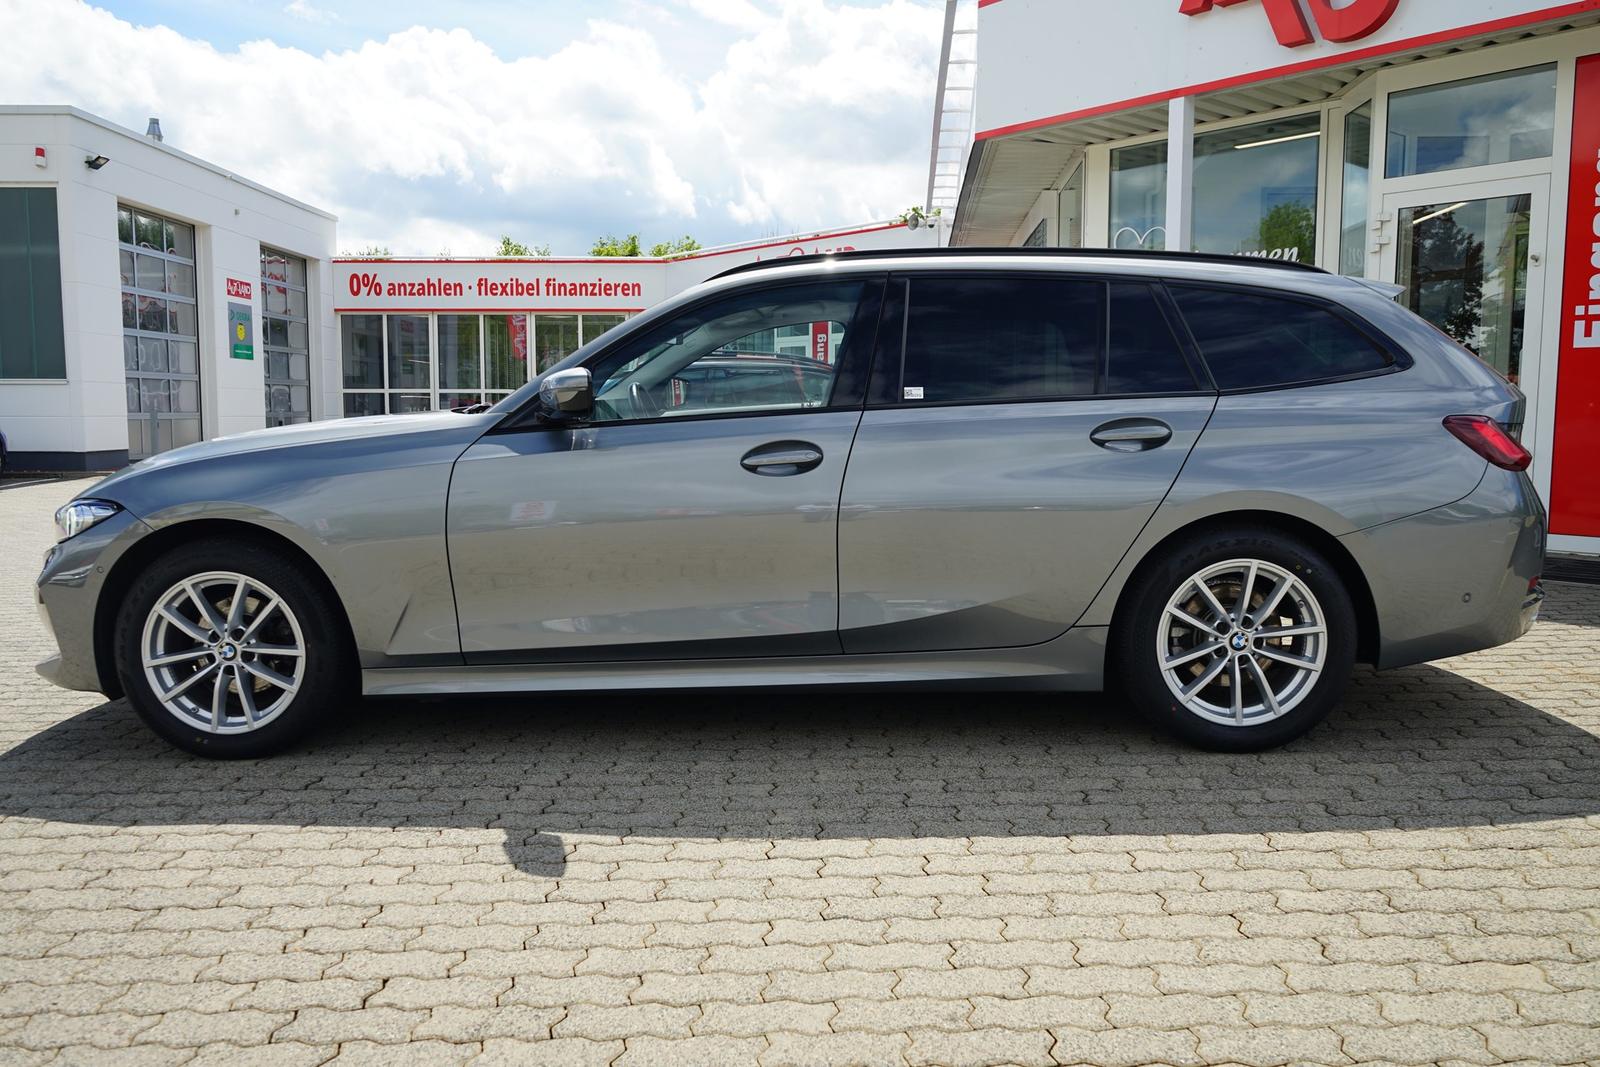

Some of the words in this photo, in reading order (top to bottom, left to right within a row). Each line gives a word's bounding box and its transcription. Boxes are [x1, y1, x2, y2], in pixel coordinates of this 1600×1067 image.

[349, 273, 383, 297] 0%
[387, 278, 463, 297] anzahlen
[477, 278, 540, 297] flexibel
[545, 278, 642, 297] finanzieren
